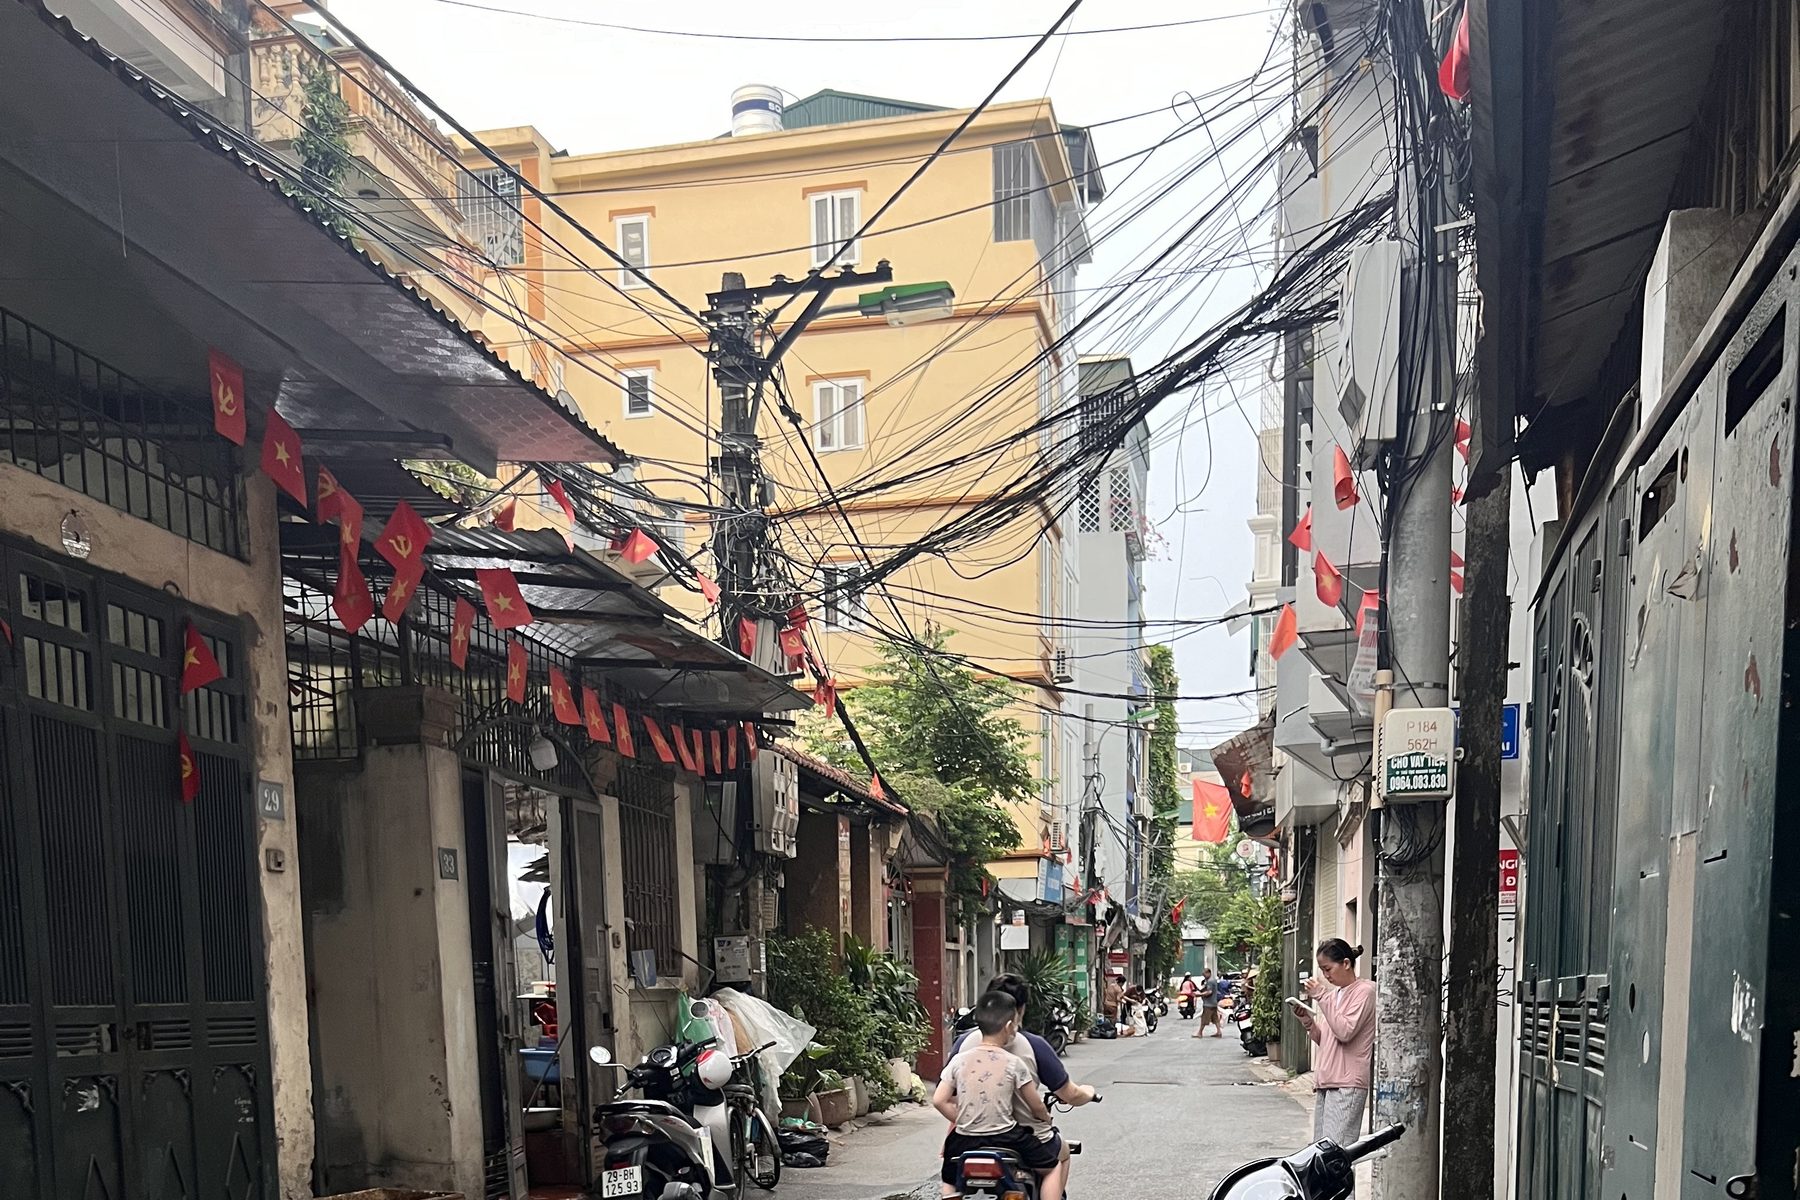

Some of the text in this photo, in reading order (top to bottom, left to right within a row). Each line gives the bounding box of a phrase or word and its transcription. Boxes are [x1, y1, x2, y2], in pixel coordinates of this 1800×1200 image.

[1407, 720, 1437, 733] P 184
[1407, 738, 1438, 751] 562H
[1390, 756, 1409, 769] CHO
[1410, 755, 1425, 768] VAY
[1389, 773, 1446, 791] 0964.083.830
[264, 788, 279, 812] 29
[443, 854, 455, 873] 33
[607, 1168, 635, 1183] 29-BH
[605, 1180, 639, 1196] 125.93
